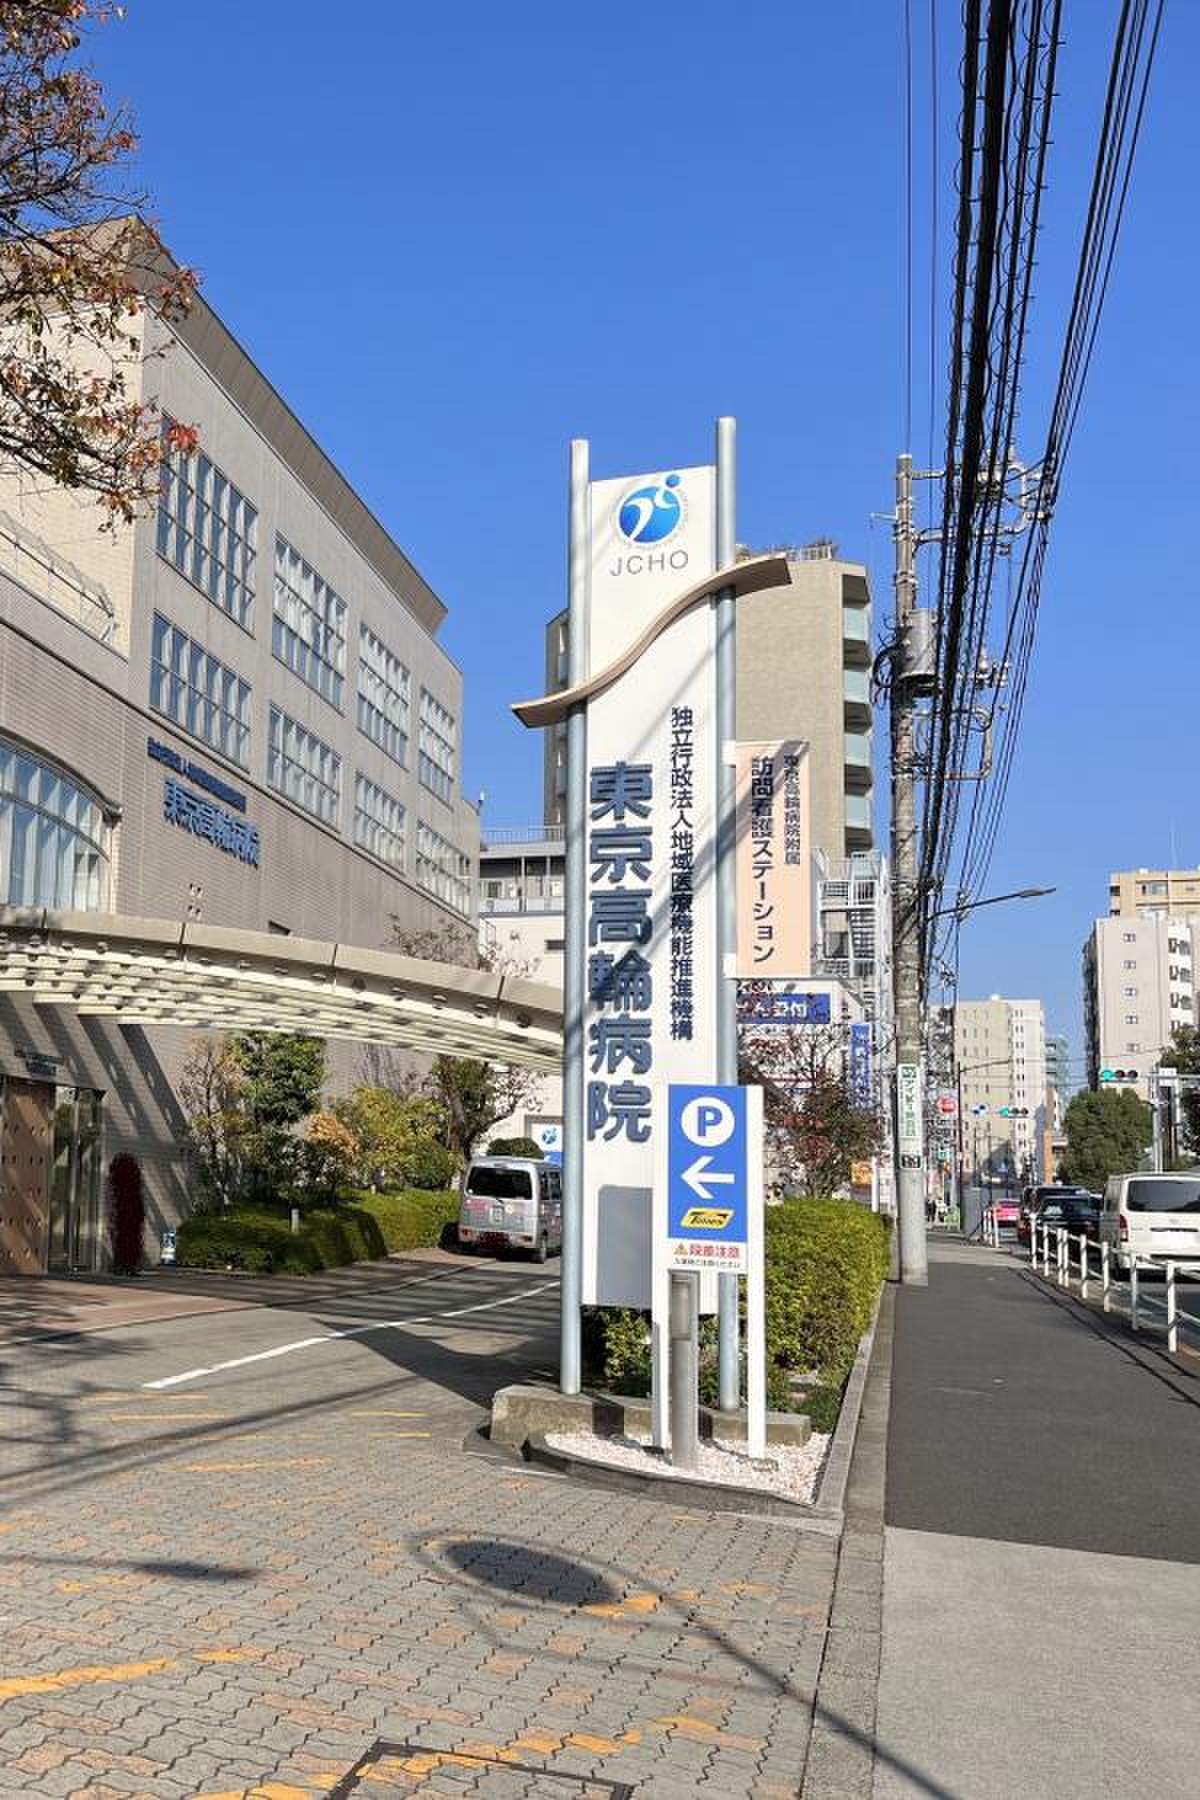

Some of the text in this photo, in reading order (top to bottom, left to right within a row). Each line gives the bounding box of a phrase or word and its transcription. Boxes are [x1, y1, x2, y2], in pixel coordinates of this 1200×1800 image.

[610, 550, 689, 577] JCHO
[588, 760, 653, 1144] 東京高輪病院
[670, 705, 694, 1041] 独立行政法人地域医療機能推進機構
[751, 757, 775, 963] 訪問看護ステーション
[697, 1105, 723, 1138] P
